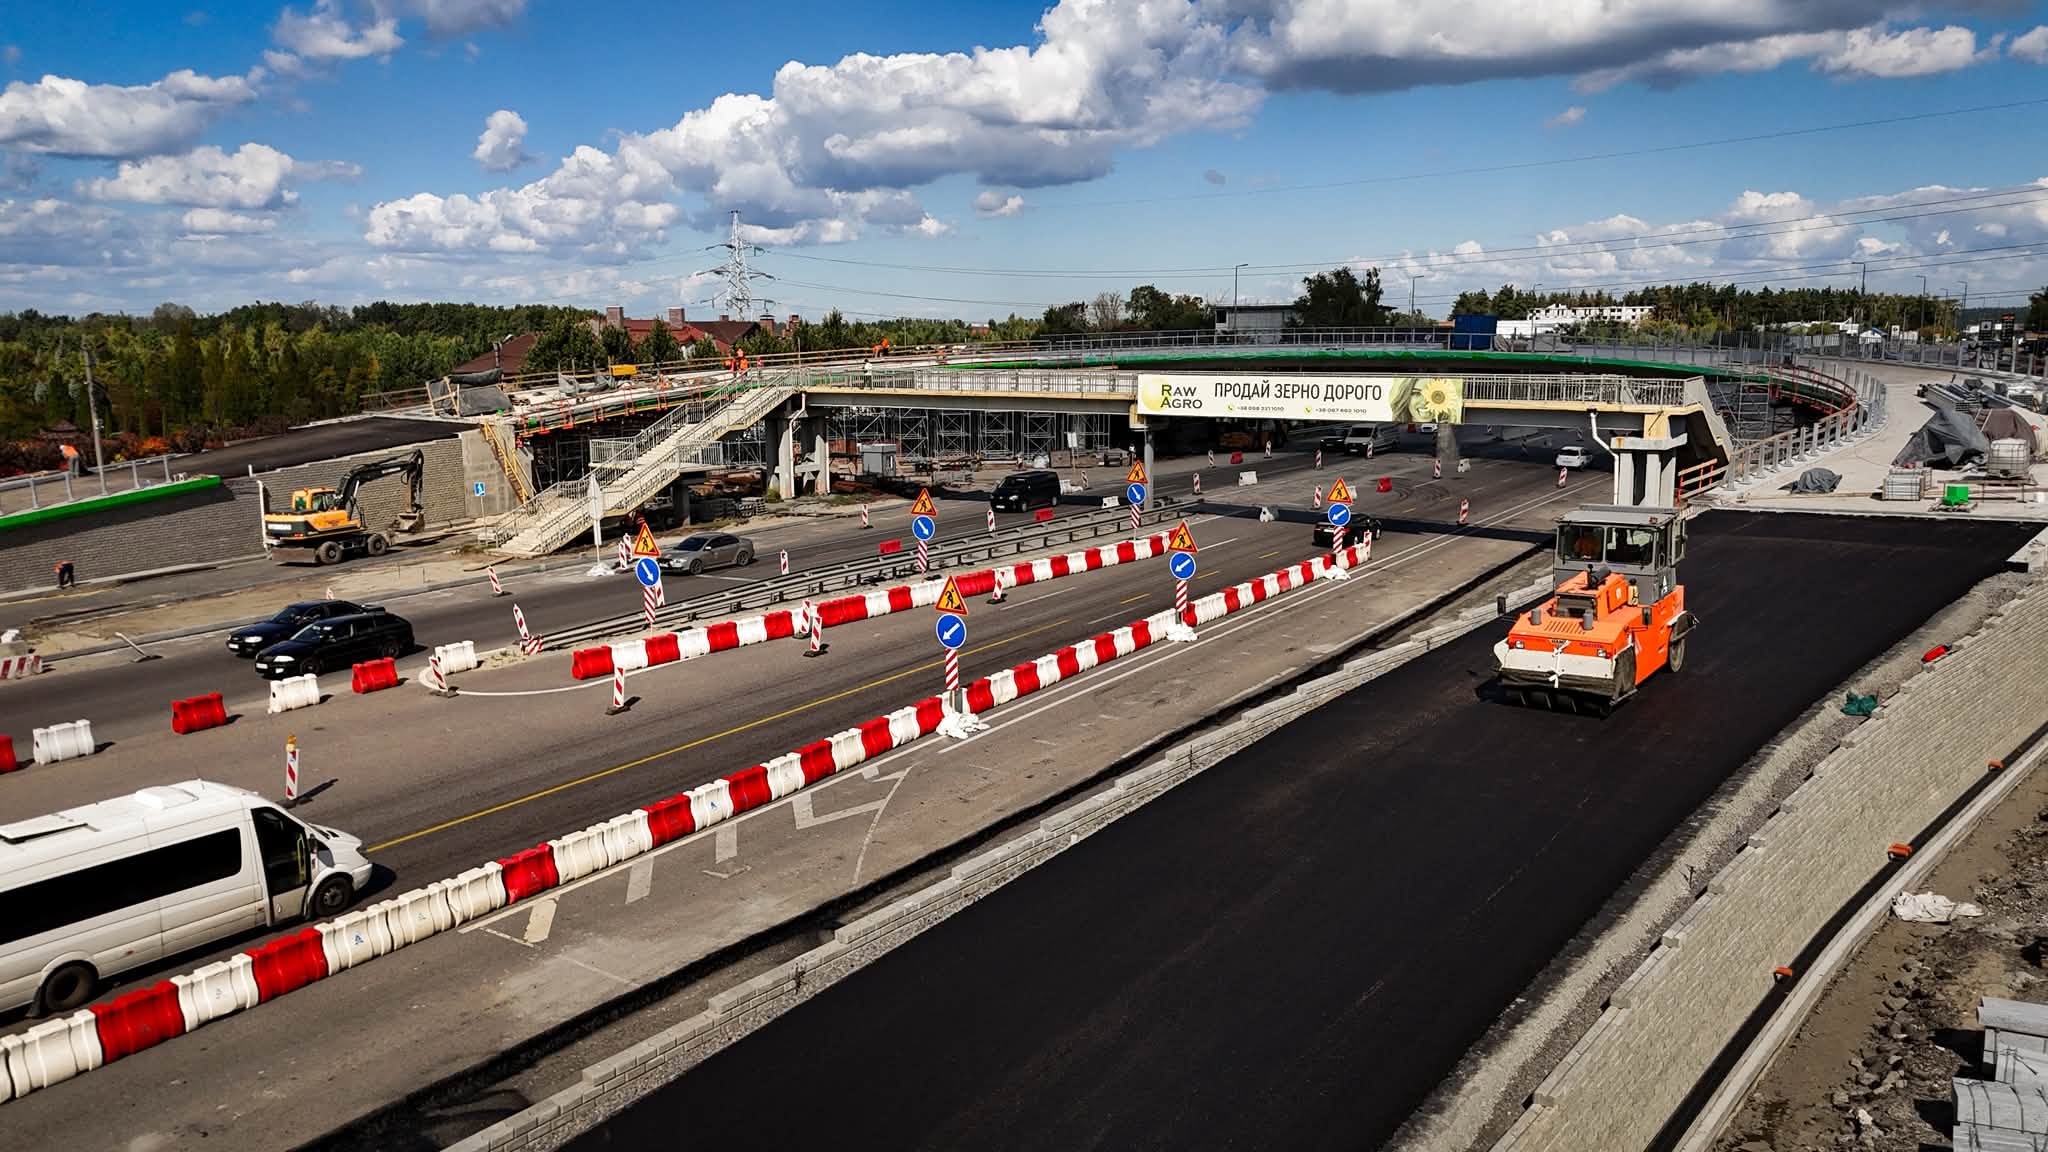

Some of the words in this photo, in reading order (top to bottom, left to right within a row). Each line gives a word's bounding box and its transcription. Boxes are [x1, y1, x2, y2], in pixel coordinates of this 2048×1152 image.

[1161, 384, 1197, 396] RAW
[1214, 379, 1270, 400] ПРОДАЙ
[1274, 383, 1320, 400] ЗЕРНО
[1323, 384, 1382, 402] ДОРОГО
[1160, 396, 1203, 409] AGRO
